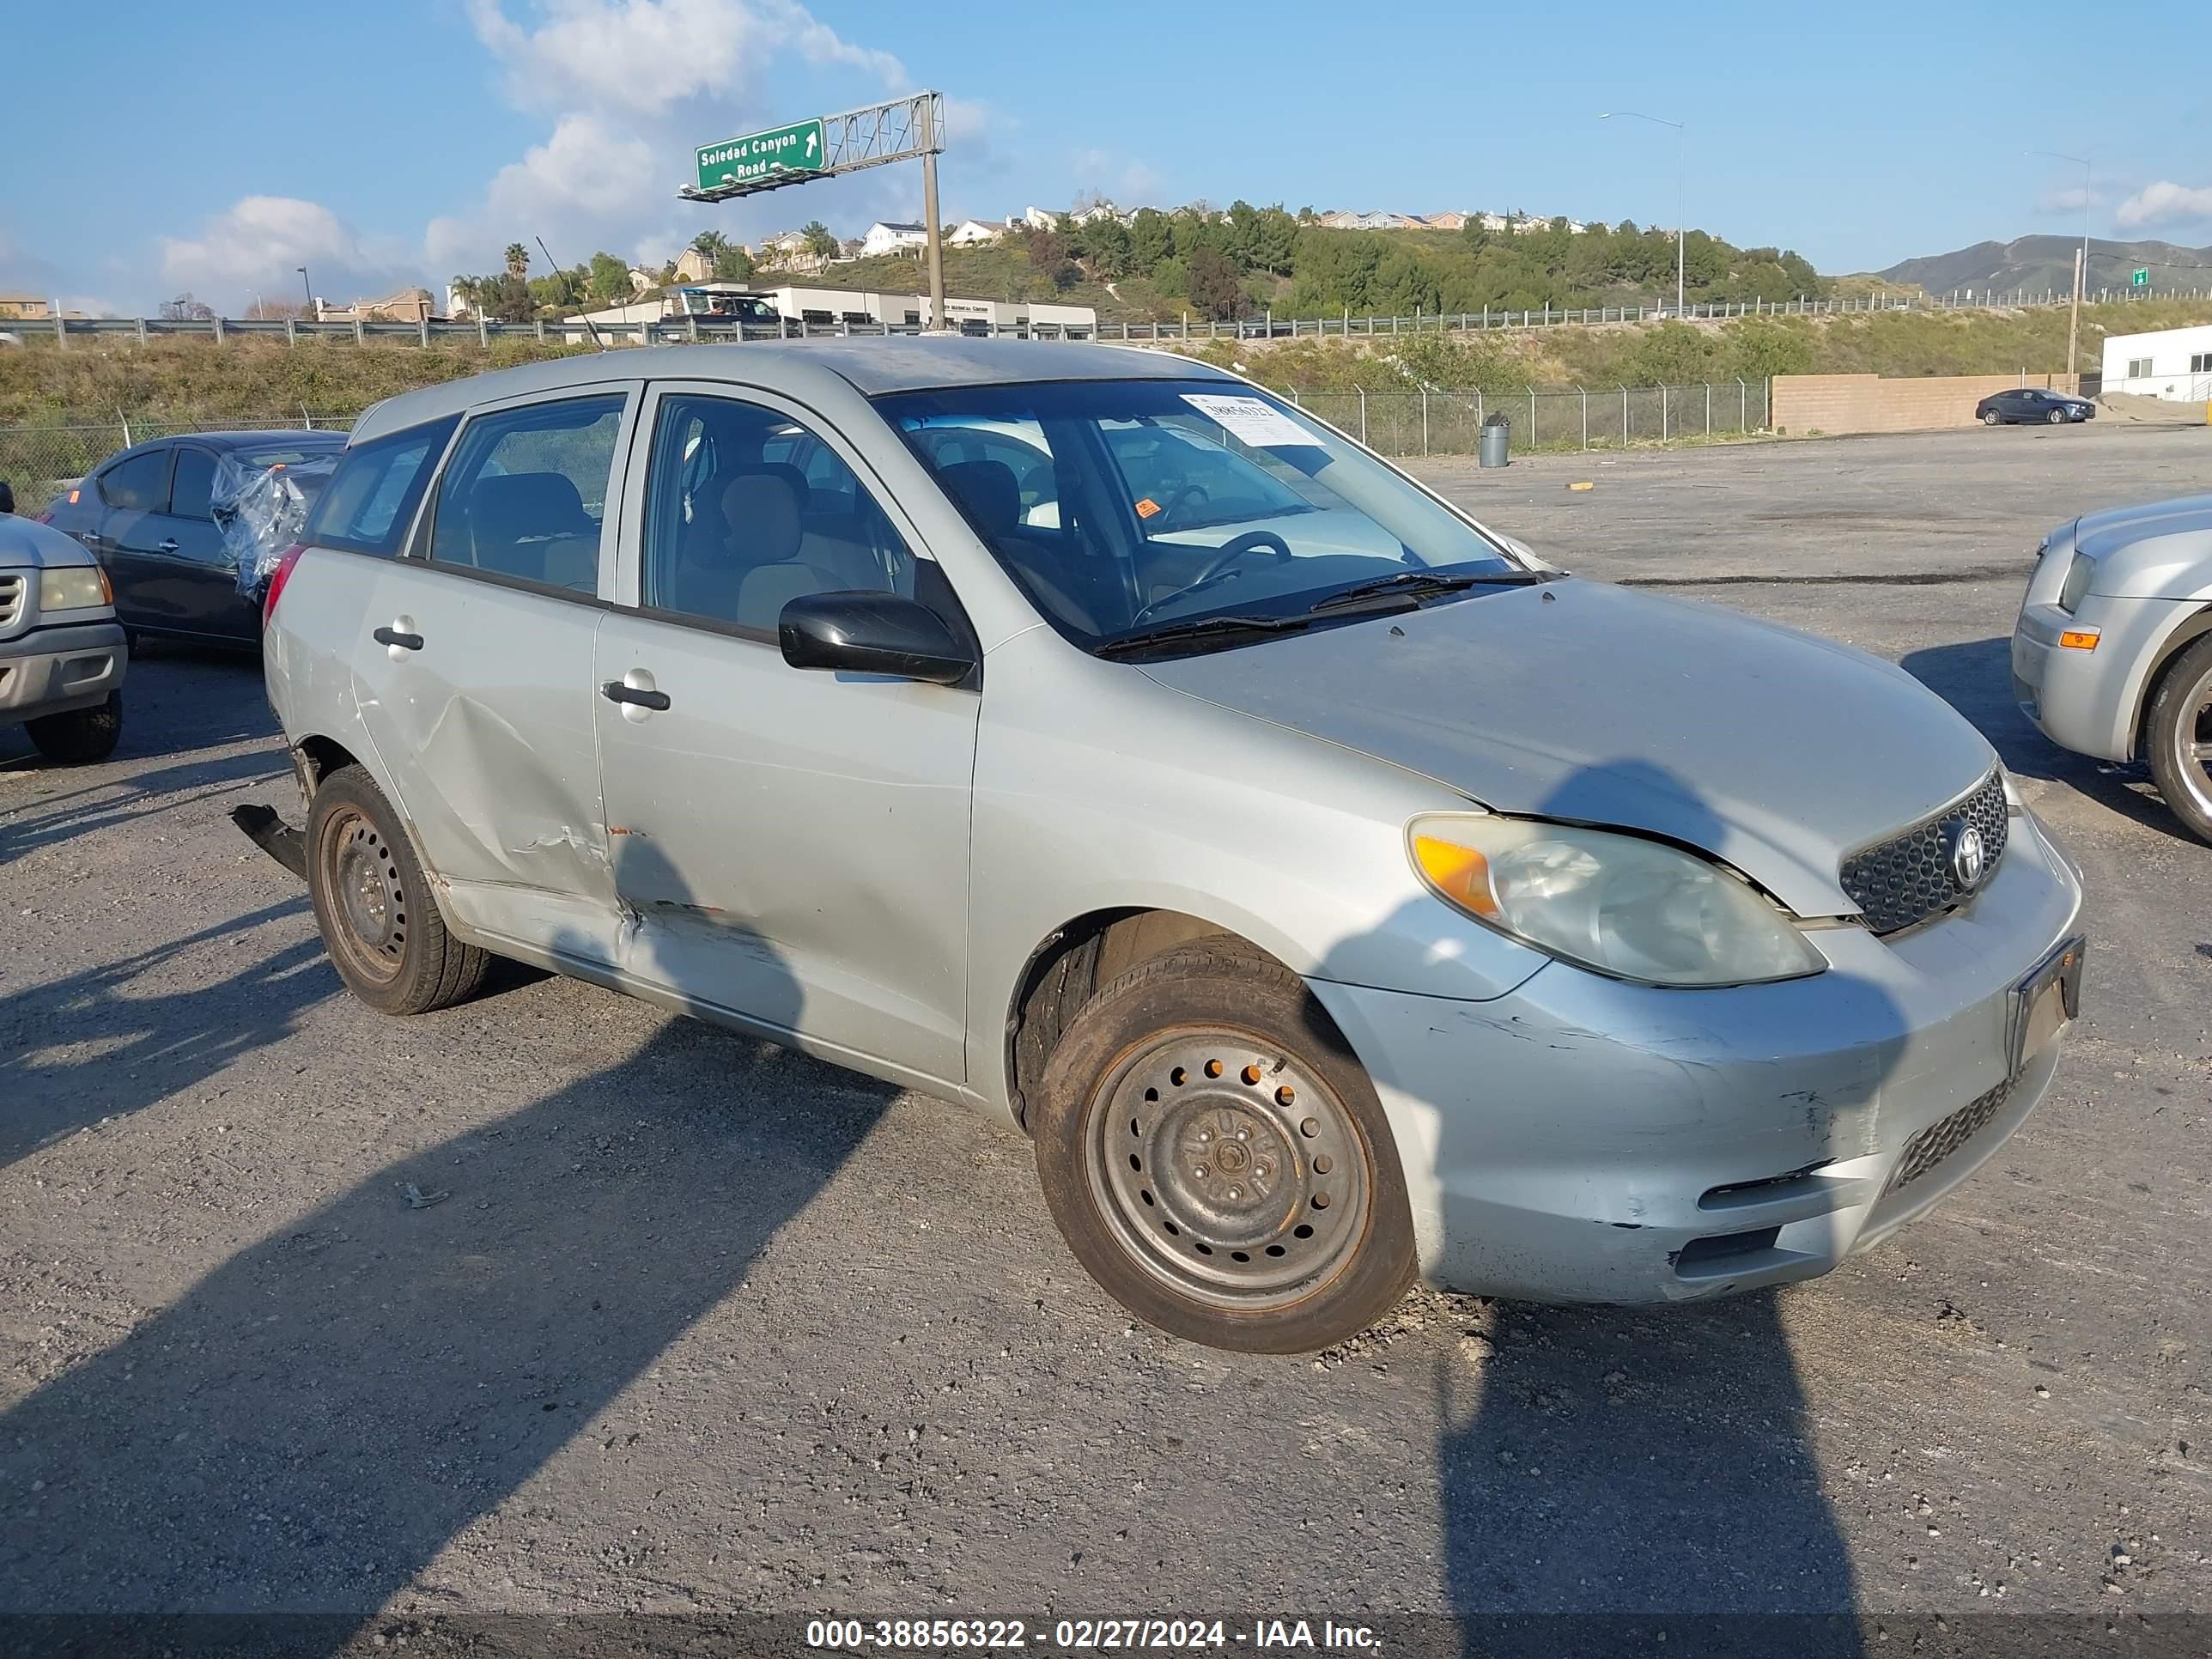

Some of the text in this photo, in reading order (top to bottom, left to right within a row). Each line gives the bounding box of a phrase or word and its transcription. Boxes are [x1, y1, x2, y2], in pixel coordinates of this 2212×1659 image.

[702, 133, 797, 167] Soledad Canyon
[737, 159, 766, 178] Road
[1206, 405, 1273, 416] 38856322
